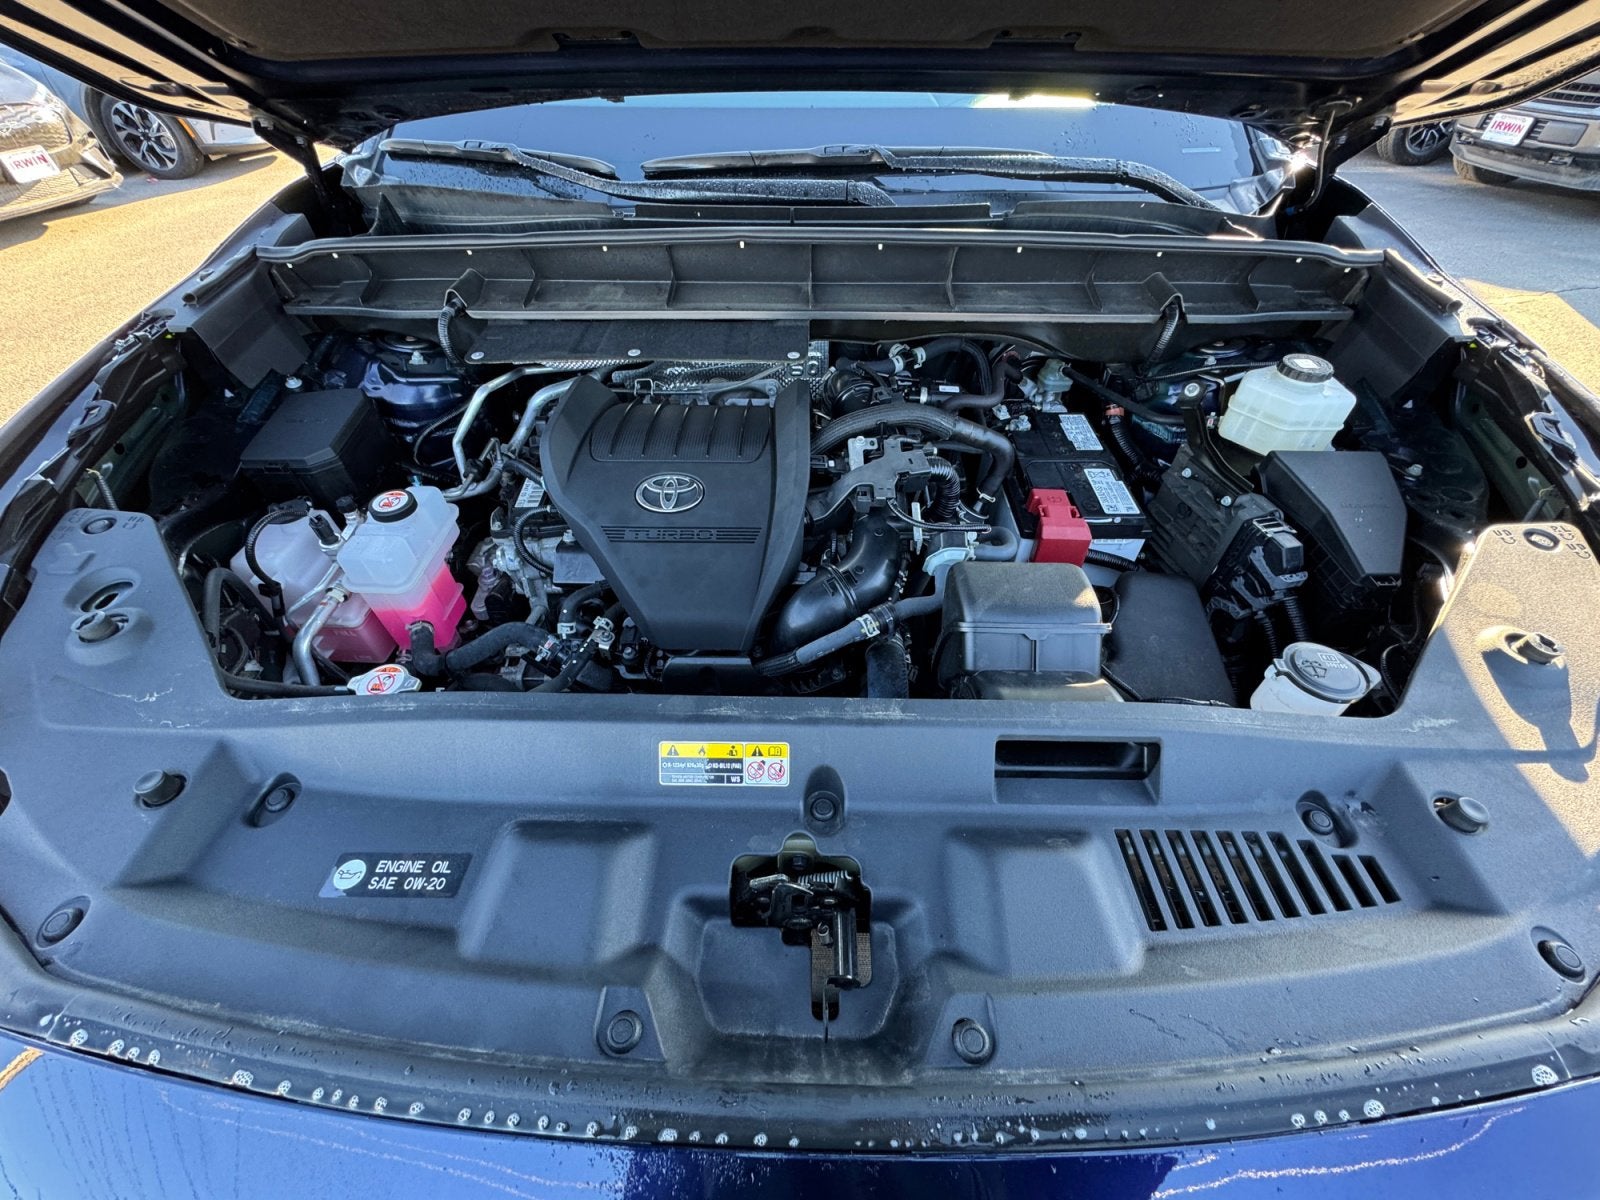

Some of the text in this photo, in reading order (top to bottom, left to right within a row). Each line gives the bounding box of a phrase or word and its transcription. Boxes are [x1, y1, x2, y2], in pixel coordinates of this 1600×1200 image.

[1490, 120, 1524, 134] IRWIN
[628, 529, 714, 540] TURBO
[730, 775, 741, 783] WS
[375, 860, 452, 874] ENGINE OIL
[367, 876, 398, 890] SAE
